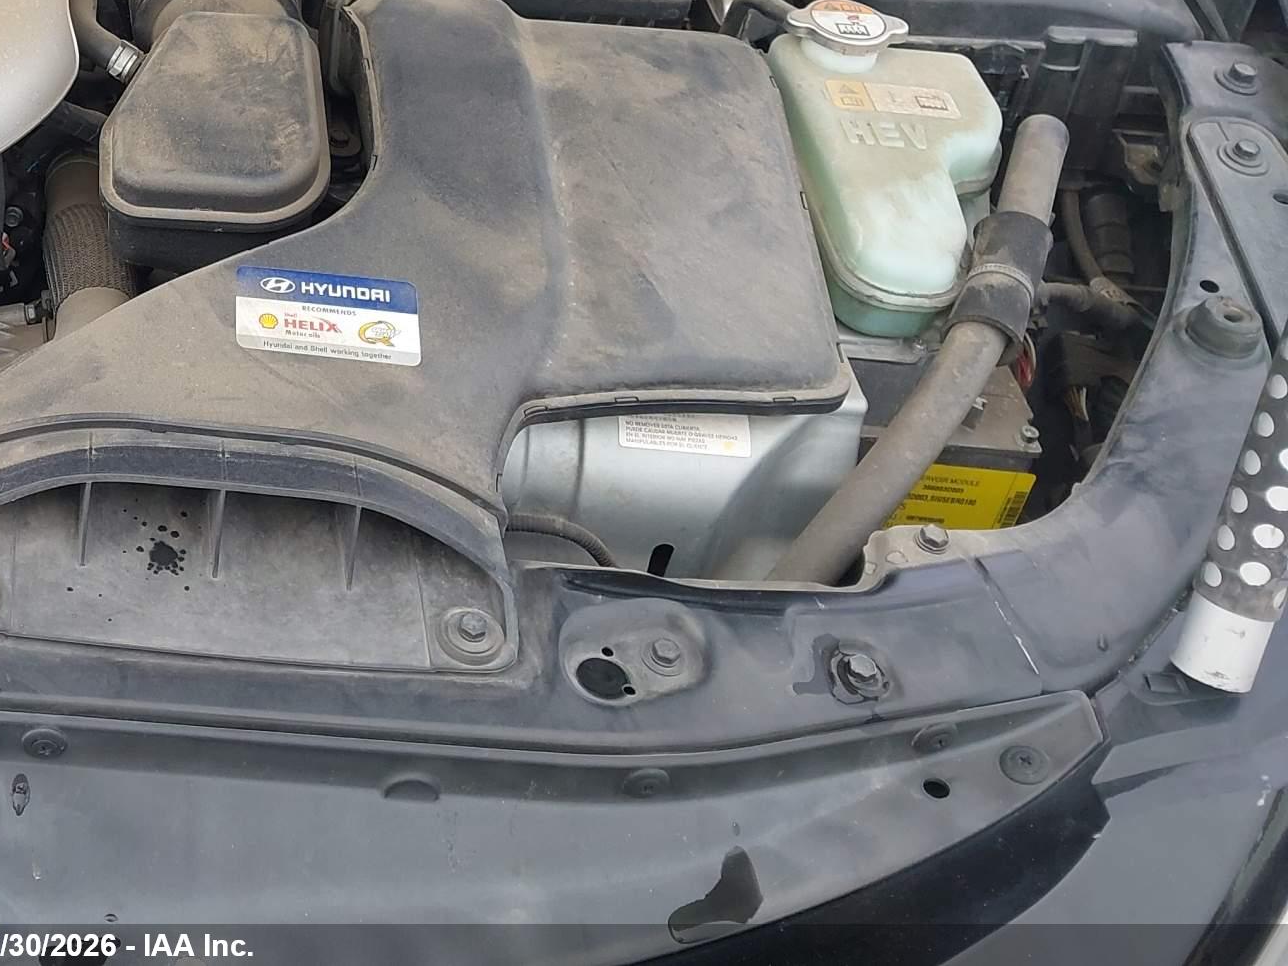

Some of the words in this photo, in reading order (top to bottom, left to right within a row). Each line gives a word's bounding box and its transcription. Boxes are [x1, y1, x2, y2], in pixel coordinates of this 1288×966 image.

[840, 116, 928, 150] HEV
[301, 281, 391, 303] HYUNDAI
[302, 305, 357, 317] RECOMMENDS
[284, 318, 342, 334] HELIX
[285, 329, 307, 337] Motor
[263, 340, 293, 351] Hyundai
[295, 342, 309, 352] and
[310, 344, 328, 354] Shell
[330, 347, 359, 358] working
[361, 349, 392, 361] together
